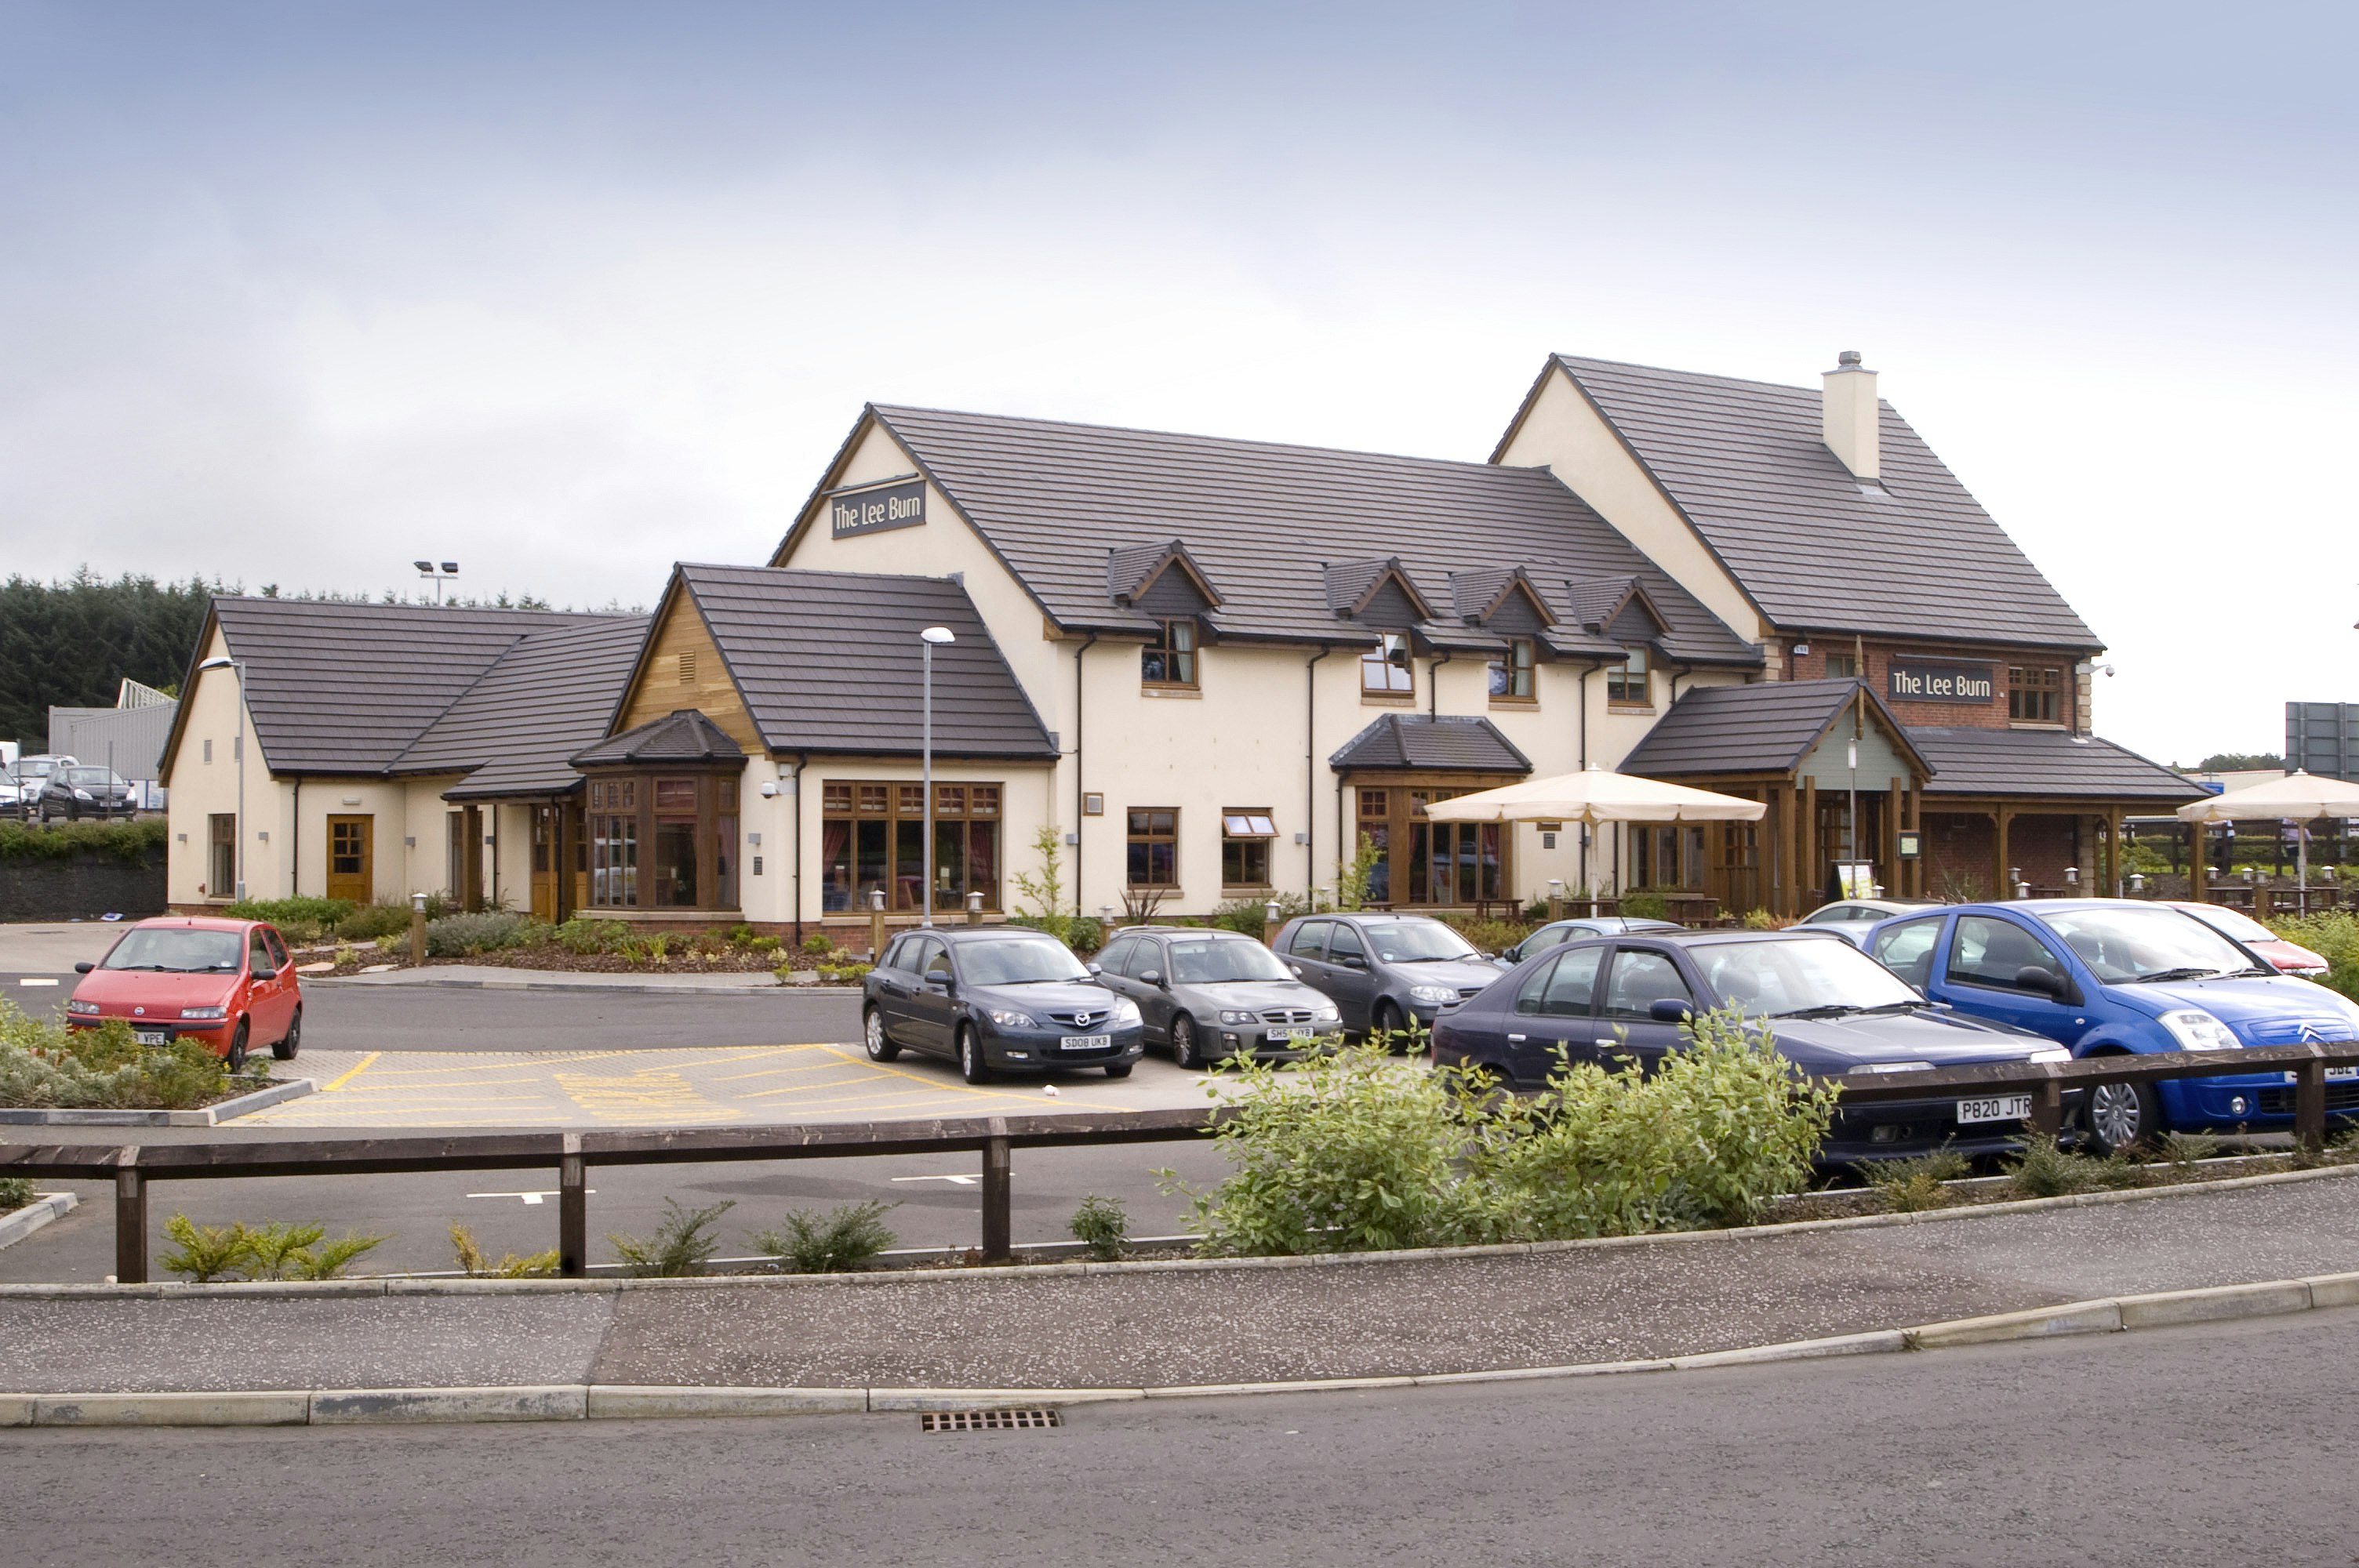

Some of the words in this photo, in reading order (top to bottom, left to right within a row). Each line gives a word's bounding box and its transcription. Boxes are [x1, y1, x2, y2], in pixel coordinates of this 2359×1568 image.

[834, 503, 859, 530] The
[862, 503, 885, 525] Lee
[889, 496, 921, 521] Burn
[1893, 670, 1921, 694] The
[1926, 674, 1952, 695] Lee
[1956, 675, 1990, 697] Burn
[1963, 1101, 2000, 1120] P820
[2006, 1098, 2032, 1116] JTR
